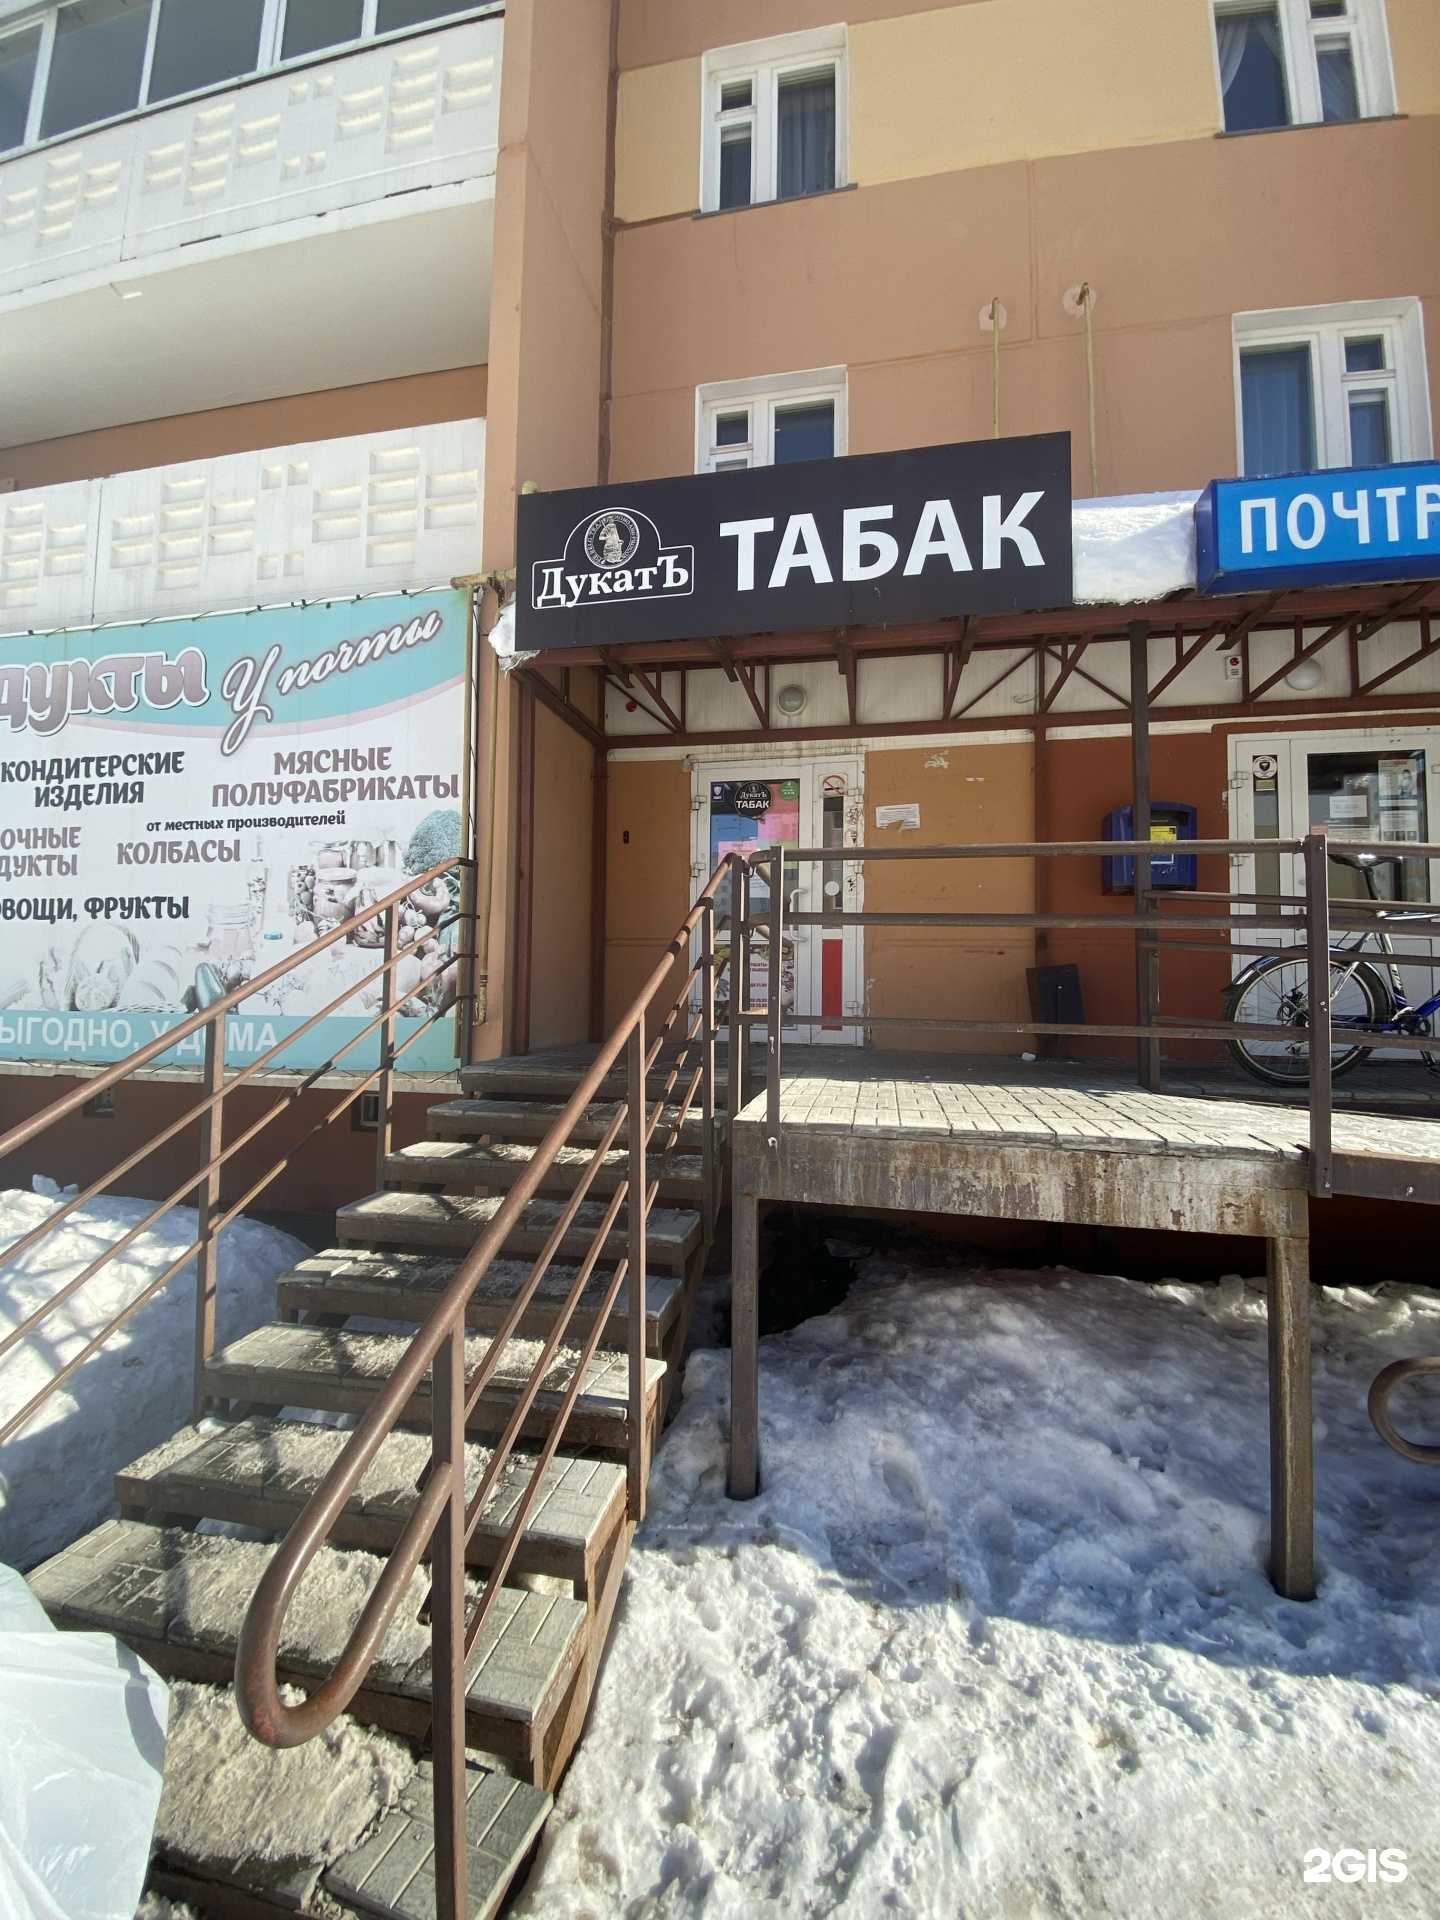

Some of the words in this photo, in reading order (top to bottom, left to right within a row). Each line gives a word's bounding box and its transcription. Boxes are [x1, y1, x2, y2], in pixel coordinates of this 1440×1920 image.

[719, 490, 1045, 592] ТАБАК
[536, 554, 689, 607] ДукатЪ
[1, 751, 185, 785] КОНДИТЕРСКИЕ
[273, 747, 392, 775] МЯСНЫЕ
[34, 781, 145, 811] ИЗДЕЛИЯ
[211, 774, 459, 807] ПОЛУФАБРИКАТЫ
[736, 800, 769, 809] ТАБАК
[146, 821, 161, 831] от
[164, 819, 224, 831] местных
[227, 810, 346, 831] производителей
[116, 839, 241, 864] КОЛБАСЫ
[0, 898, 78, 924] ВОЩИ,
[84, 896, 190, 920] ФРУКТЫ
